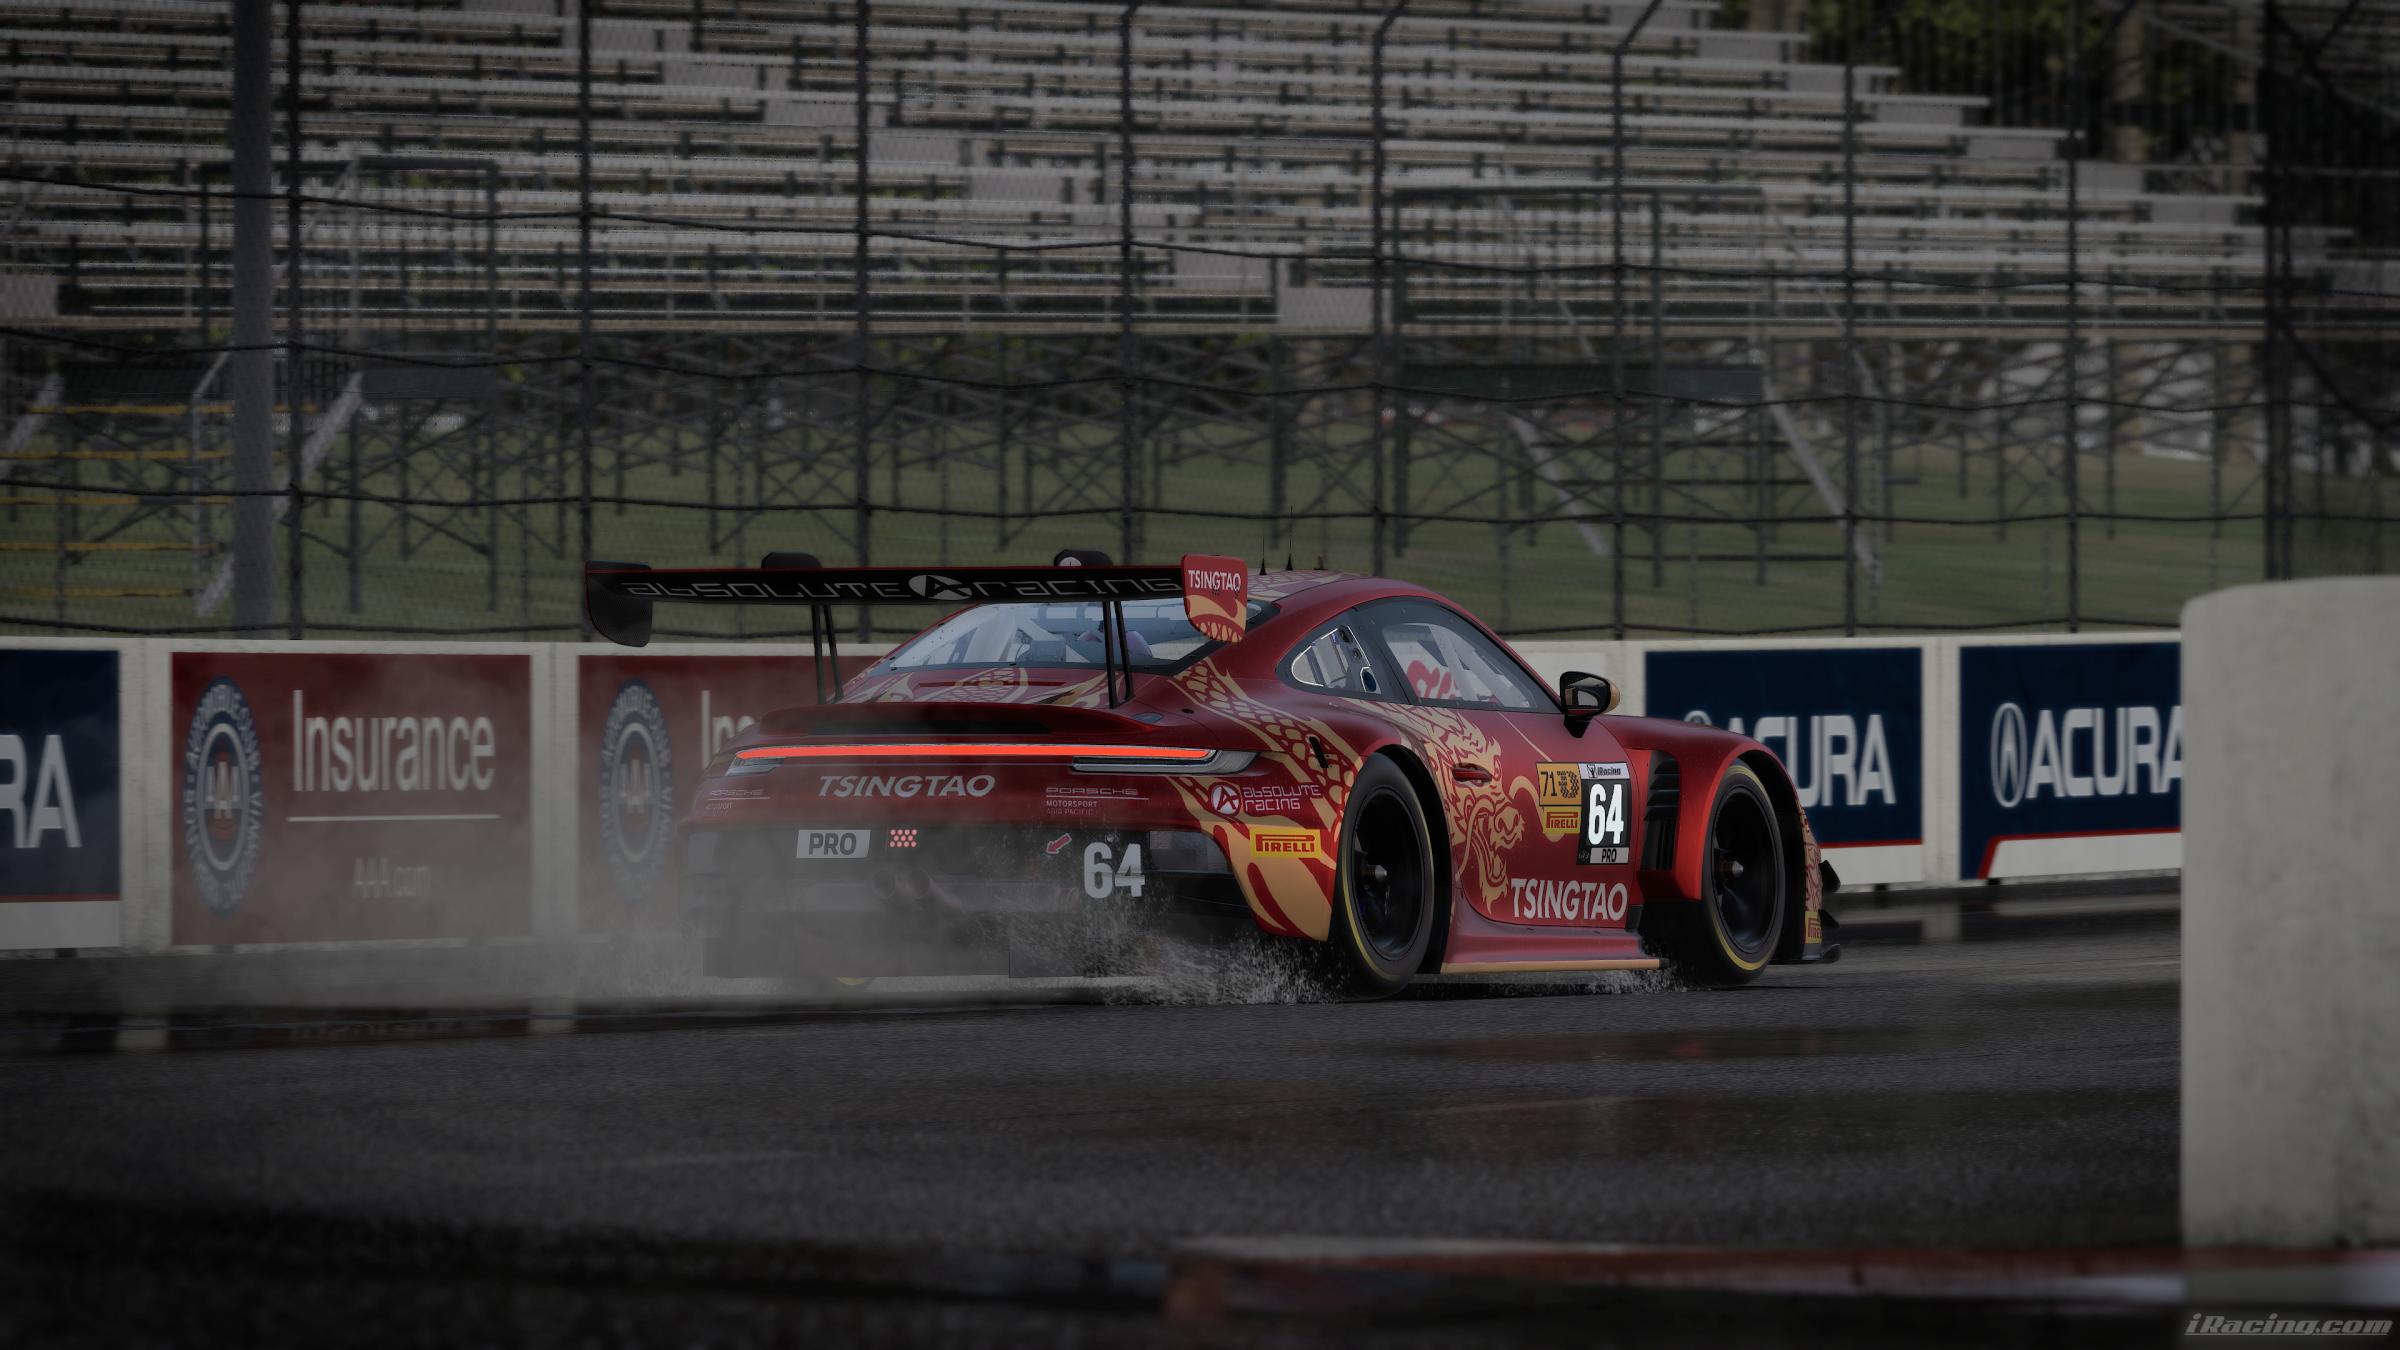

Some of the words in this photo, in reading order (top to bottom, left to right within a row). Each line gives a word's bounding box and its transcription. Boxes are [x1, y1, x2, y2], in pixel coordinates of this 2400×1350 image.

[1188, 569, 1242, 592] TSINGTAO
[292, 689, 497, 792] Insurance
[1728, 714, 1897, 808] URA
[818, 774, 997, 798] TSINGTAO
[1046, 787, 1139, 796] PORSCHE
[1046, 800, 1098, 808] MOTORSPORT
[1588, 783, 1624, 846] 64
[1546, 811, 1579, 829] PIRELLI
[809, 832, 857, 856] PRO
[1255, 834, 1316, 853] PIRELLI
[1601, 848, 1618, 863] PRO
[1084, 842, 1146, 899] 64
[1510, 877, 1629, 922] TSINGTAO
